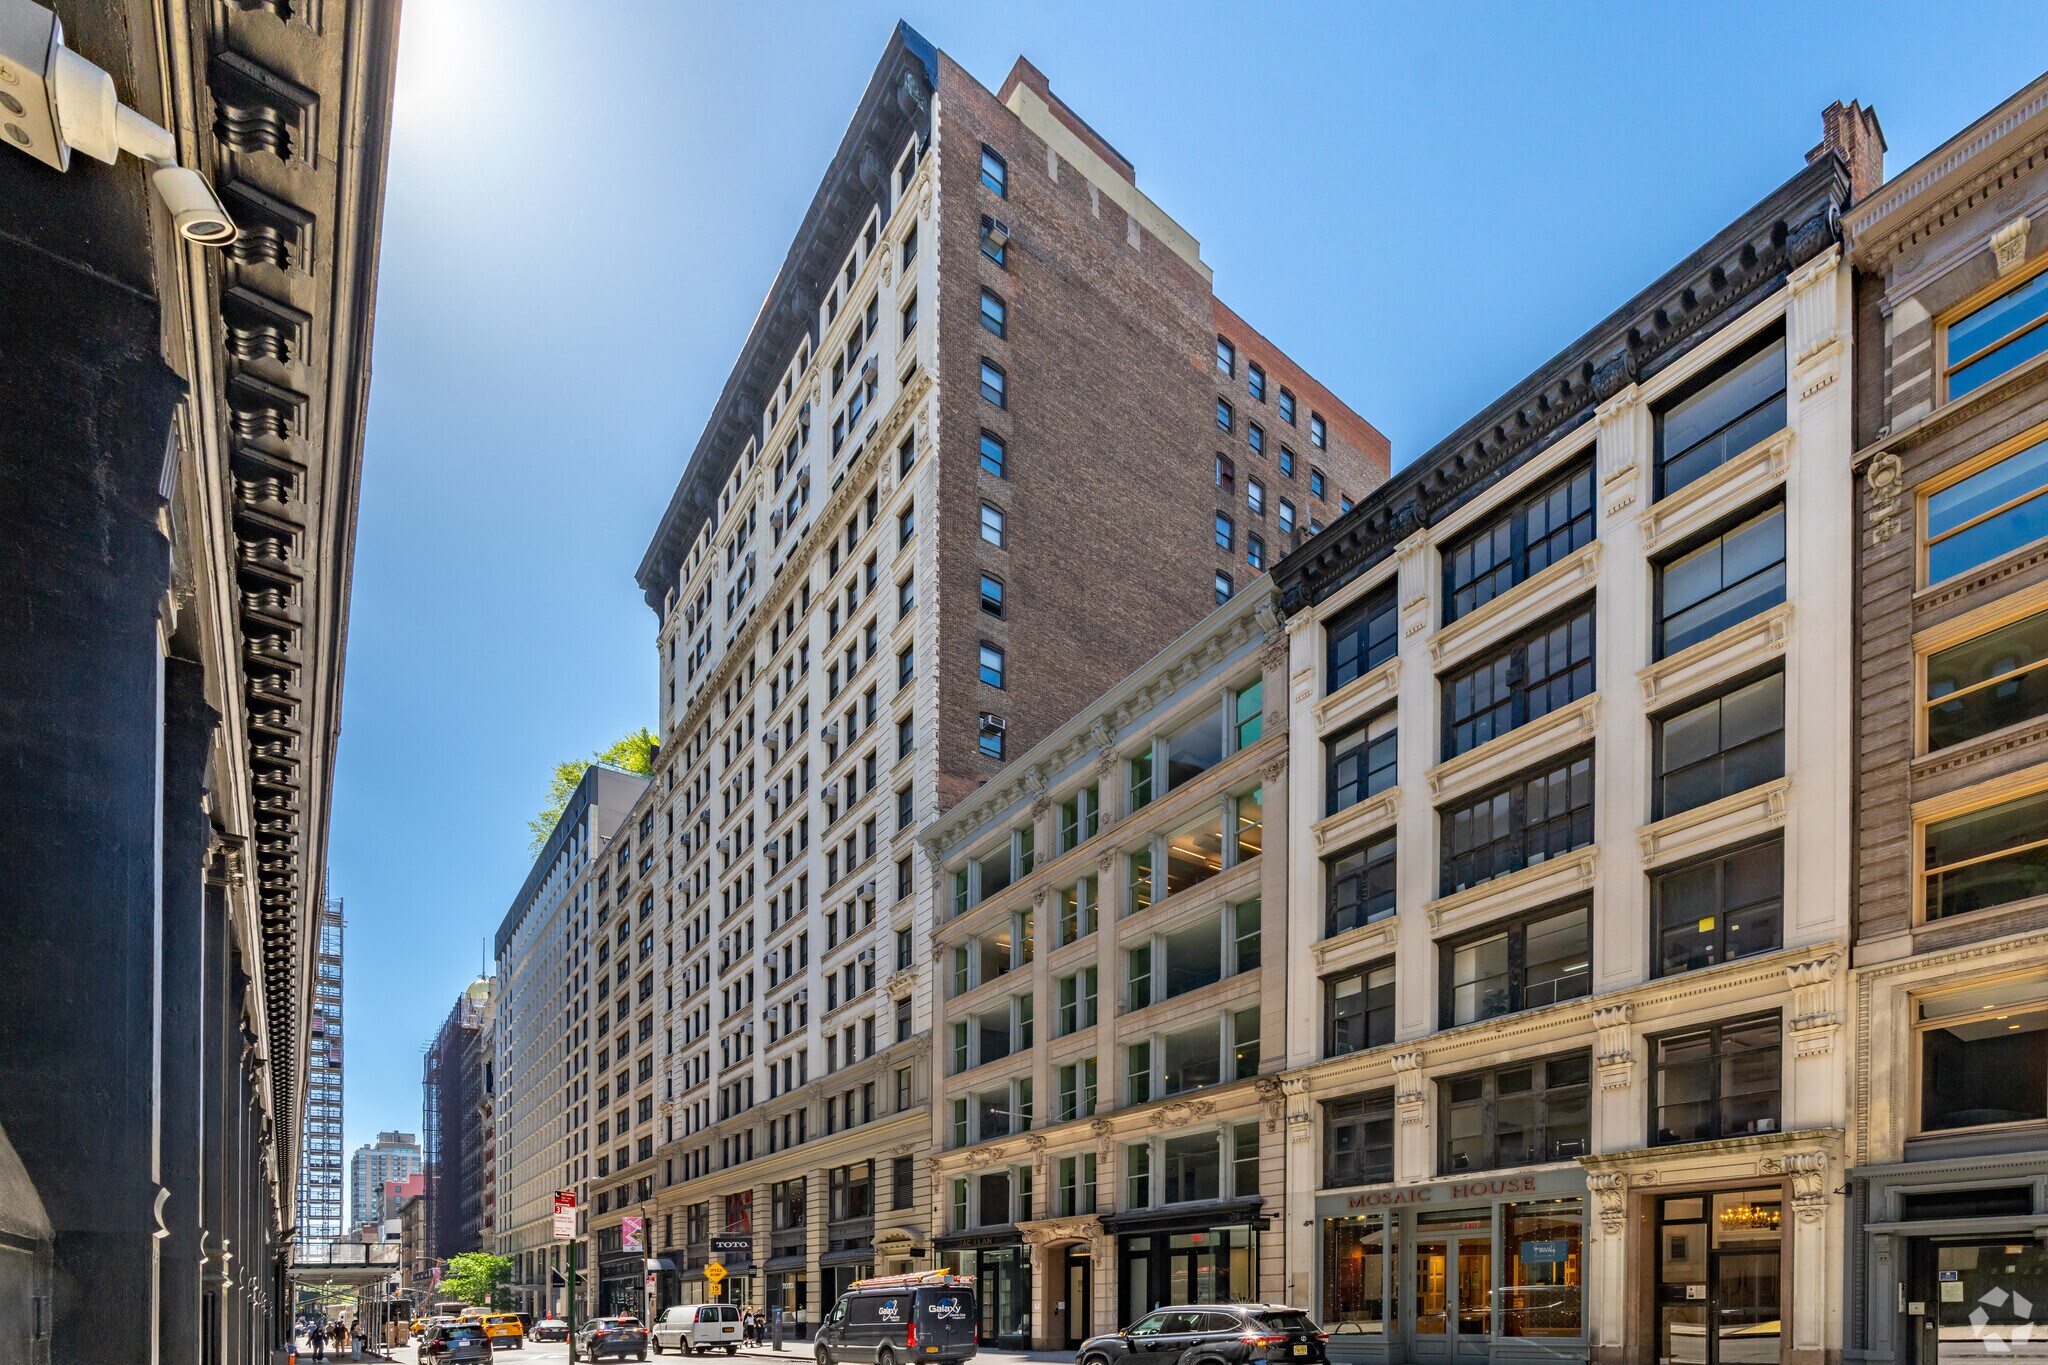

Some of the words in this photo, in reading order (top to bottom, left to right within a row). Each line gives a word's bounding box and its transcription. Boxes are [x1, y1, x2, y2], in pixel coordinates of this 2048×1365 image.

[1346, 1188, 1432, 1209] MOSAIC
[1450, 1176, 1536, 1199] HOUSE
[878, 1306, 899, 1316] Galaxy
[928, 1304, 962, 1313] Galaxy
